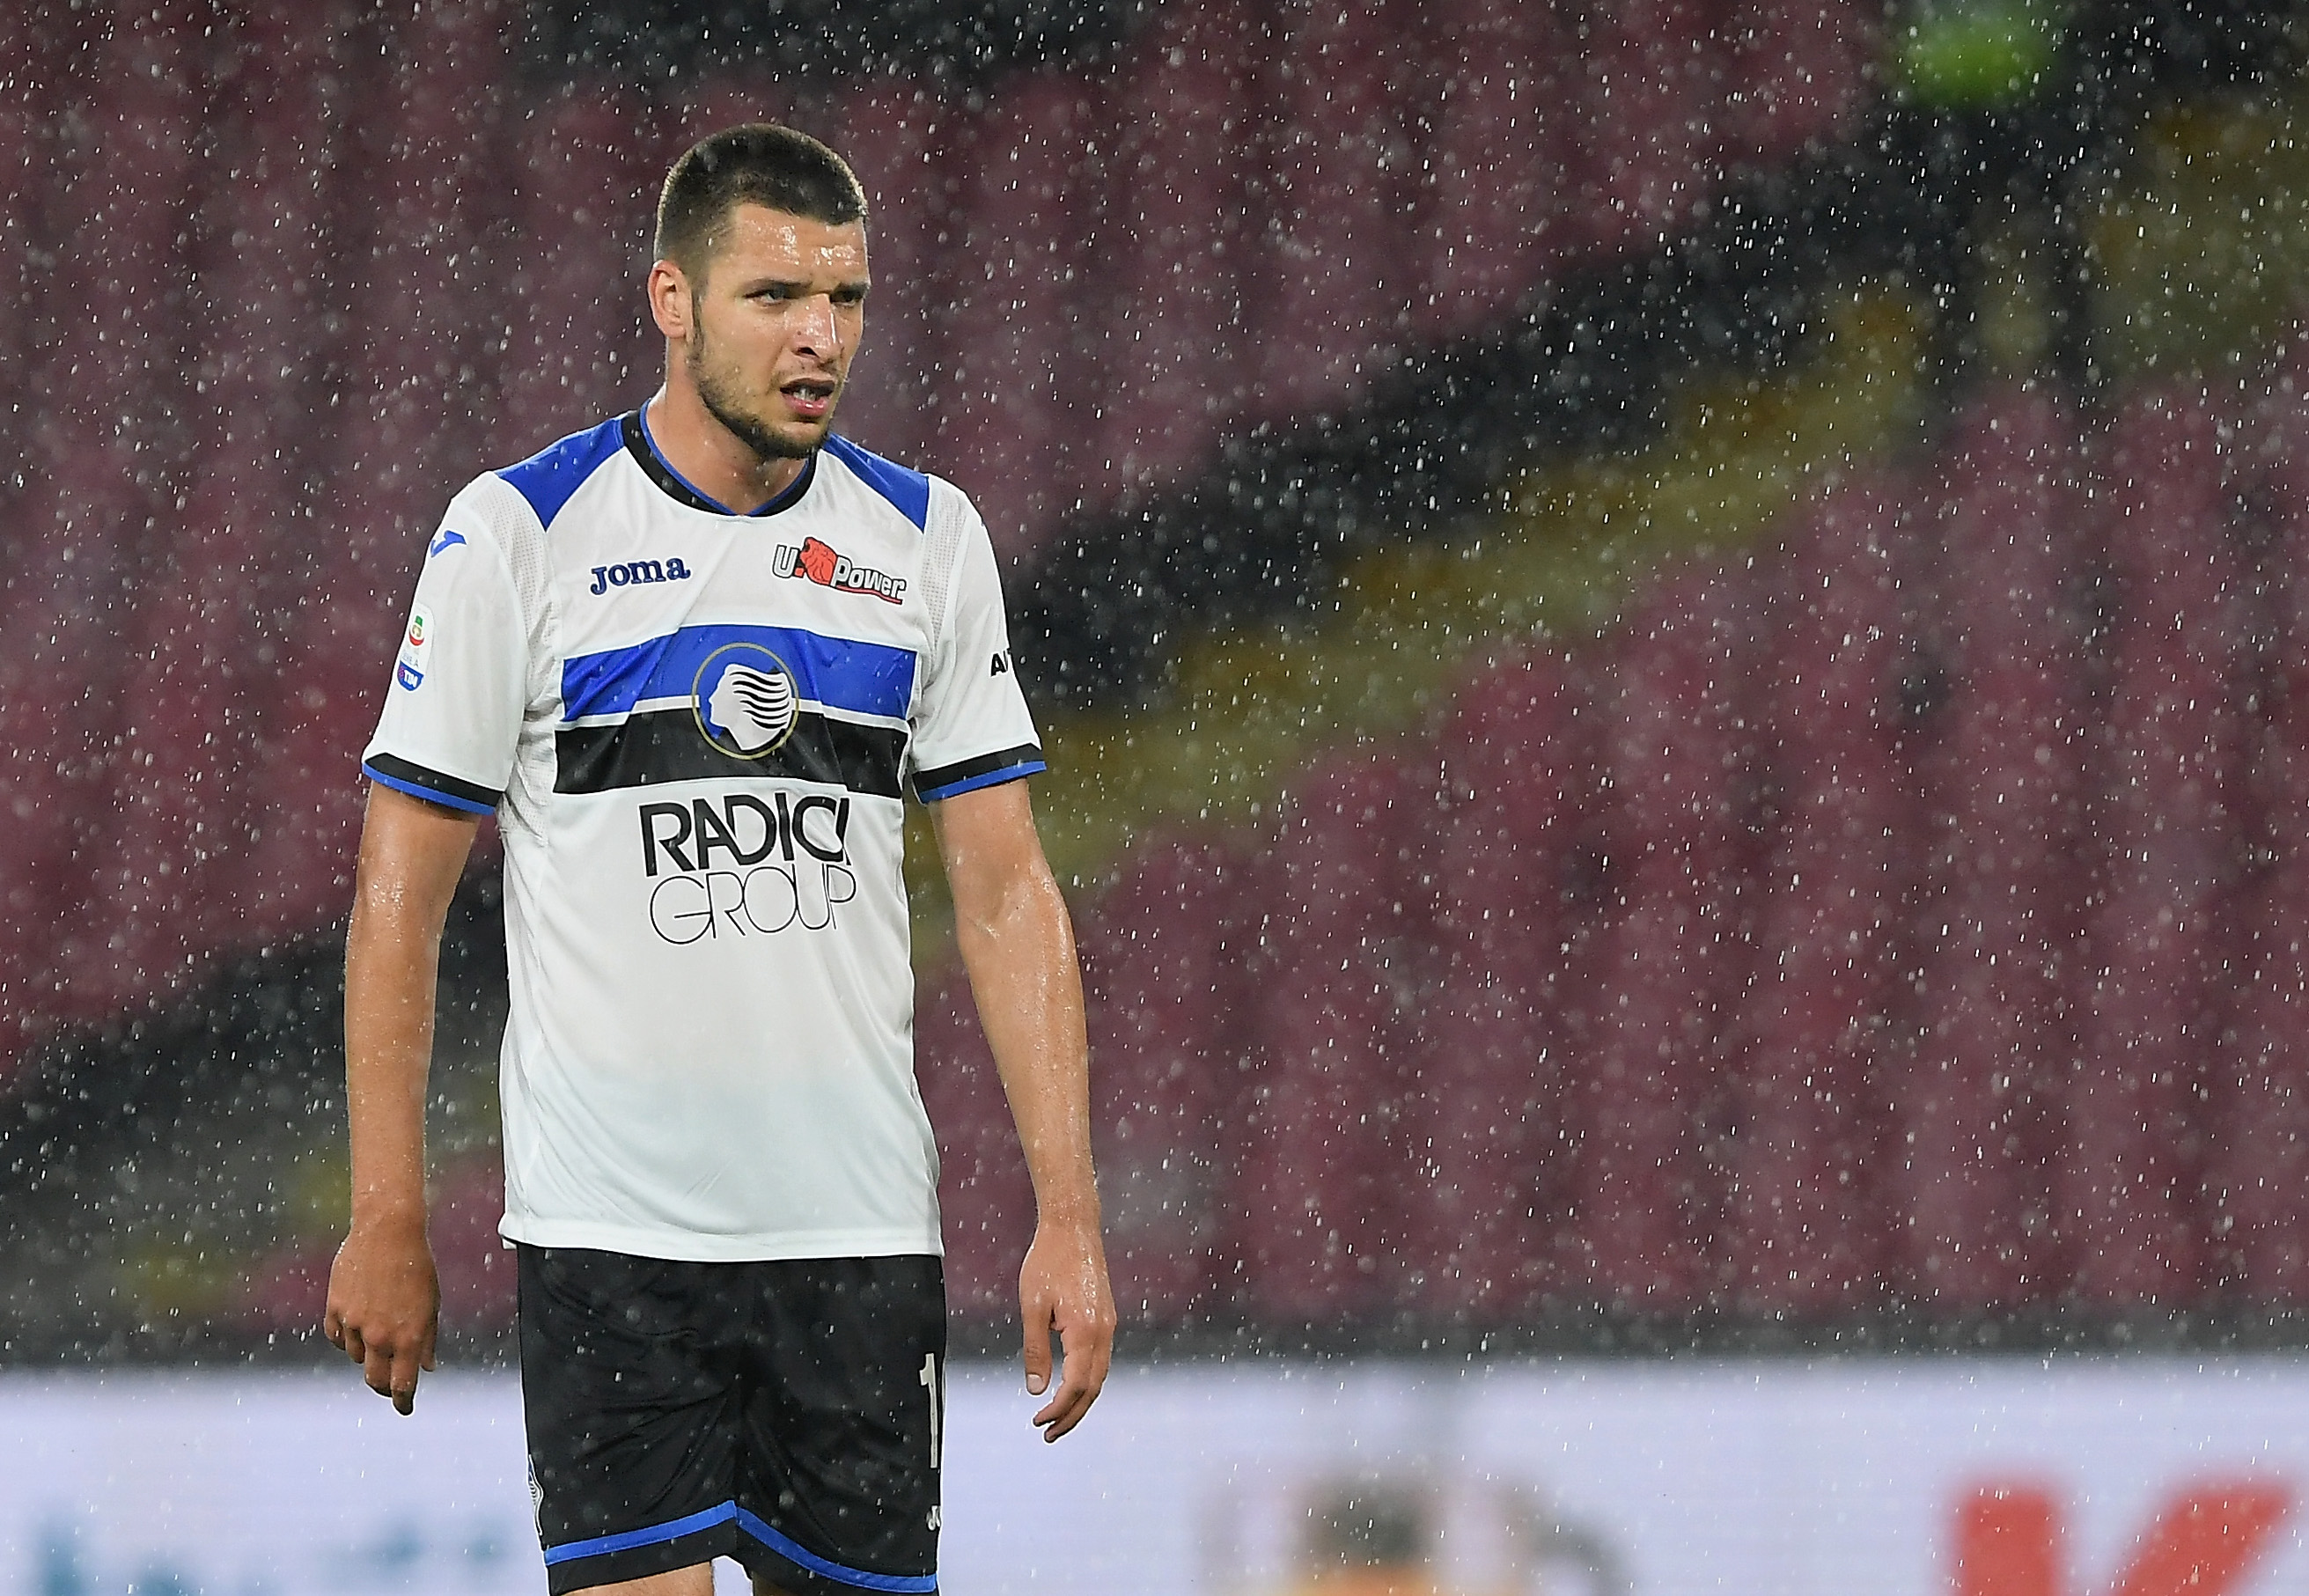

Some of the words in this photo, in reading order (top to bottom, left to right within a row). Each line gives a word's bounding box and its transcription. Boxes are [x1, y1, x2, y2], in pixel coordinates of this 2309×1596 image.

[590, 557, 691, 596] Joma
[830, 555, 907, 600] Power
[639, 792, 851, 877] RADICI
[650, 860, 857, 945] GROUP
